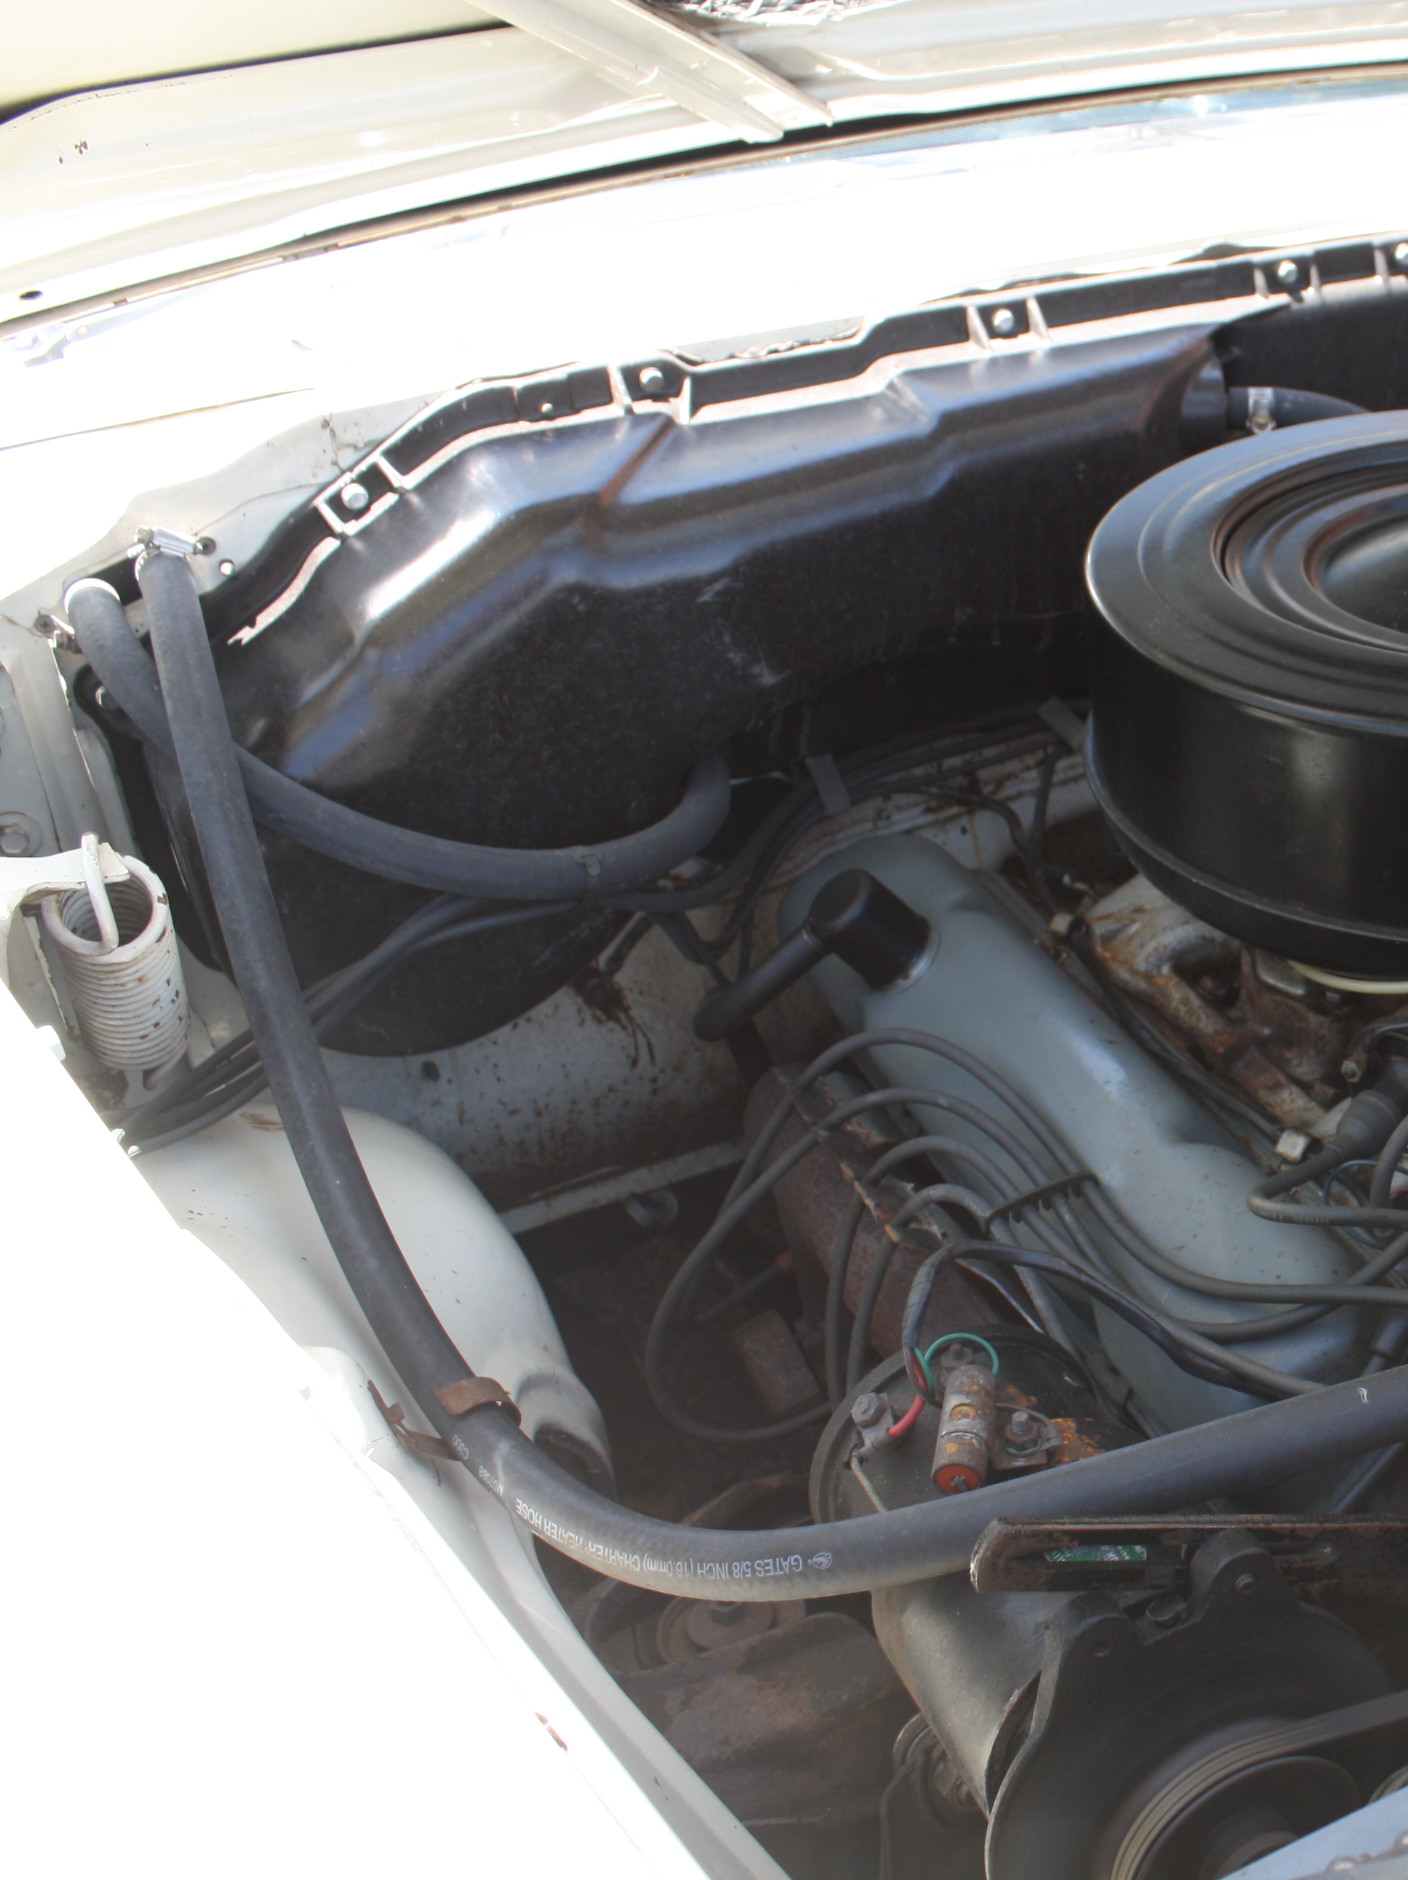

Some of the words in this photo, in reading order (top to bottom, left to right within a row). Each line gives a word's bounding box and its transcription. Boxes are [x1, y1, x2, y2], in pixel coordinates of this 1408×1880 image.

[515, 1498, 542, 1530] HOSE
[544, 1518, 583, 1552] HEATER
[697, 1562, 729, 1580] INCH
[732, 1560, 752, 1579] 5/8
[754, 1554, 802, 1577] GATES
